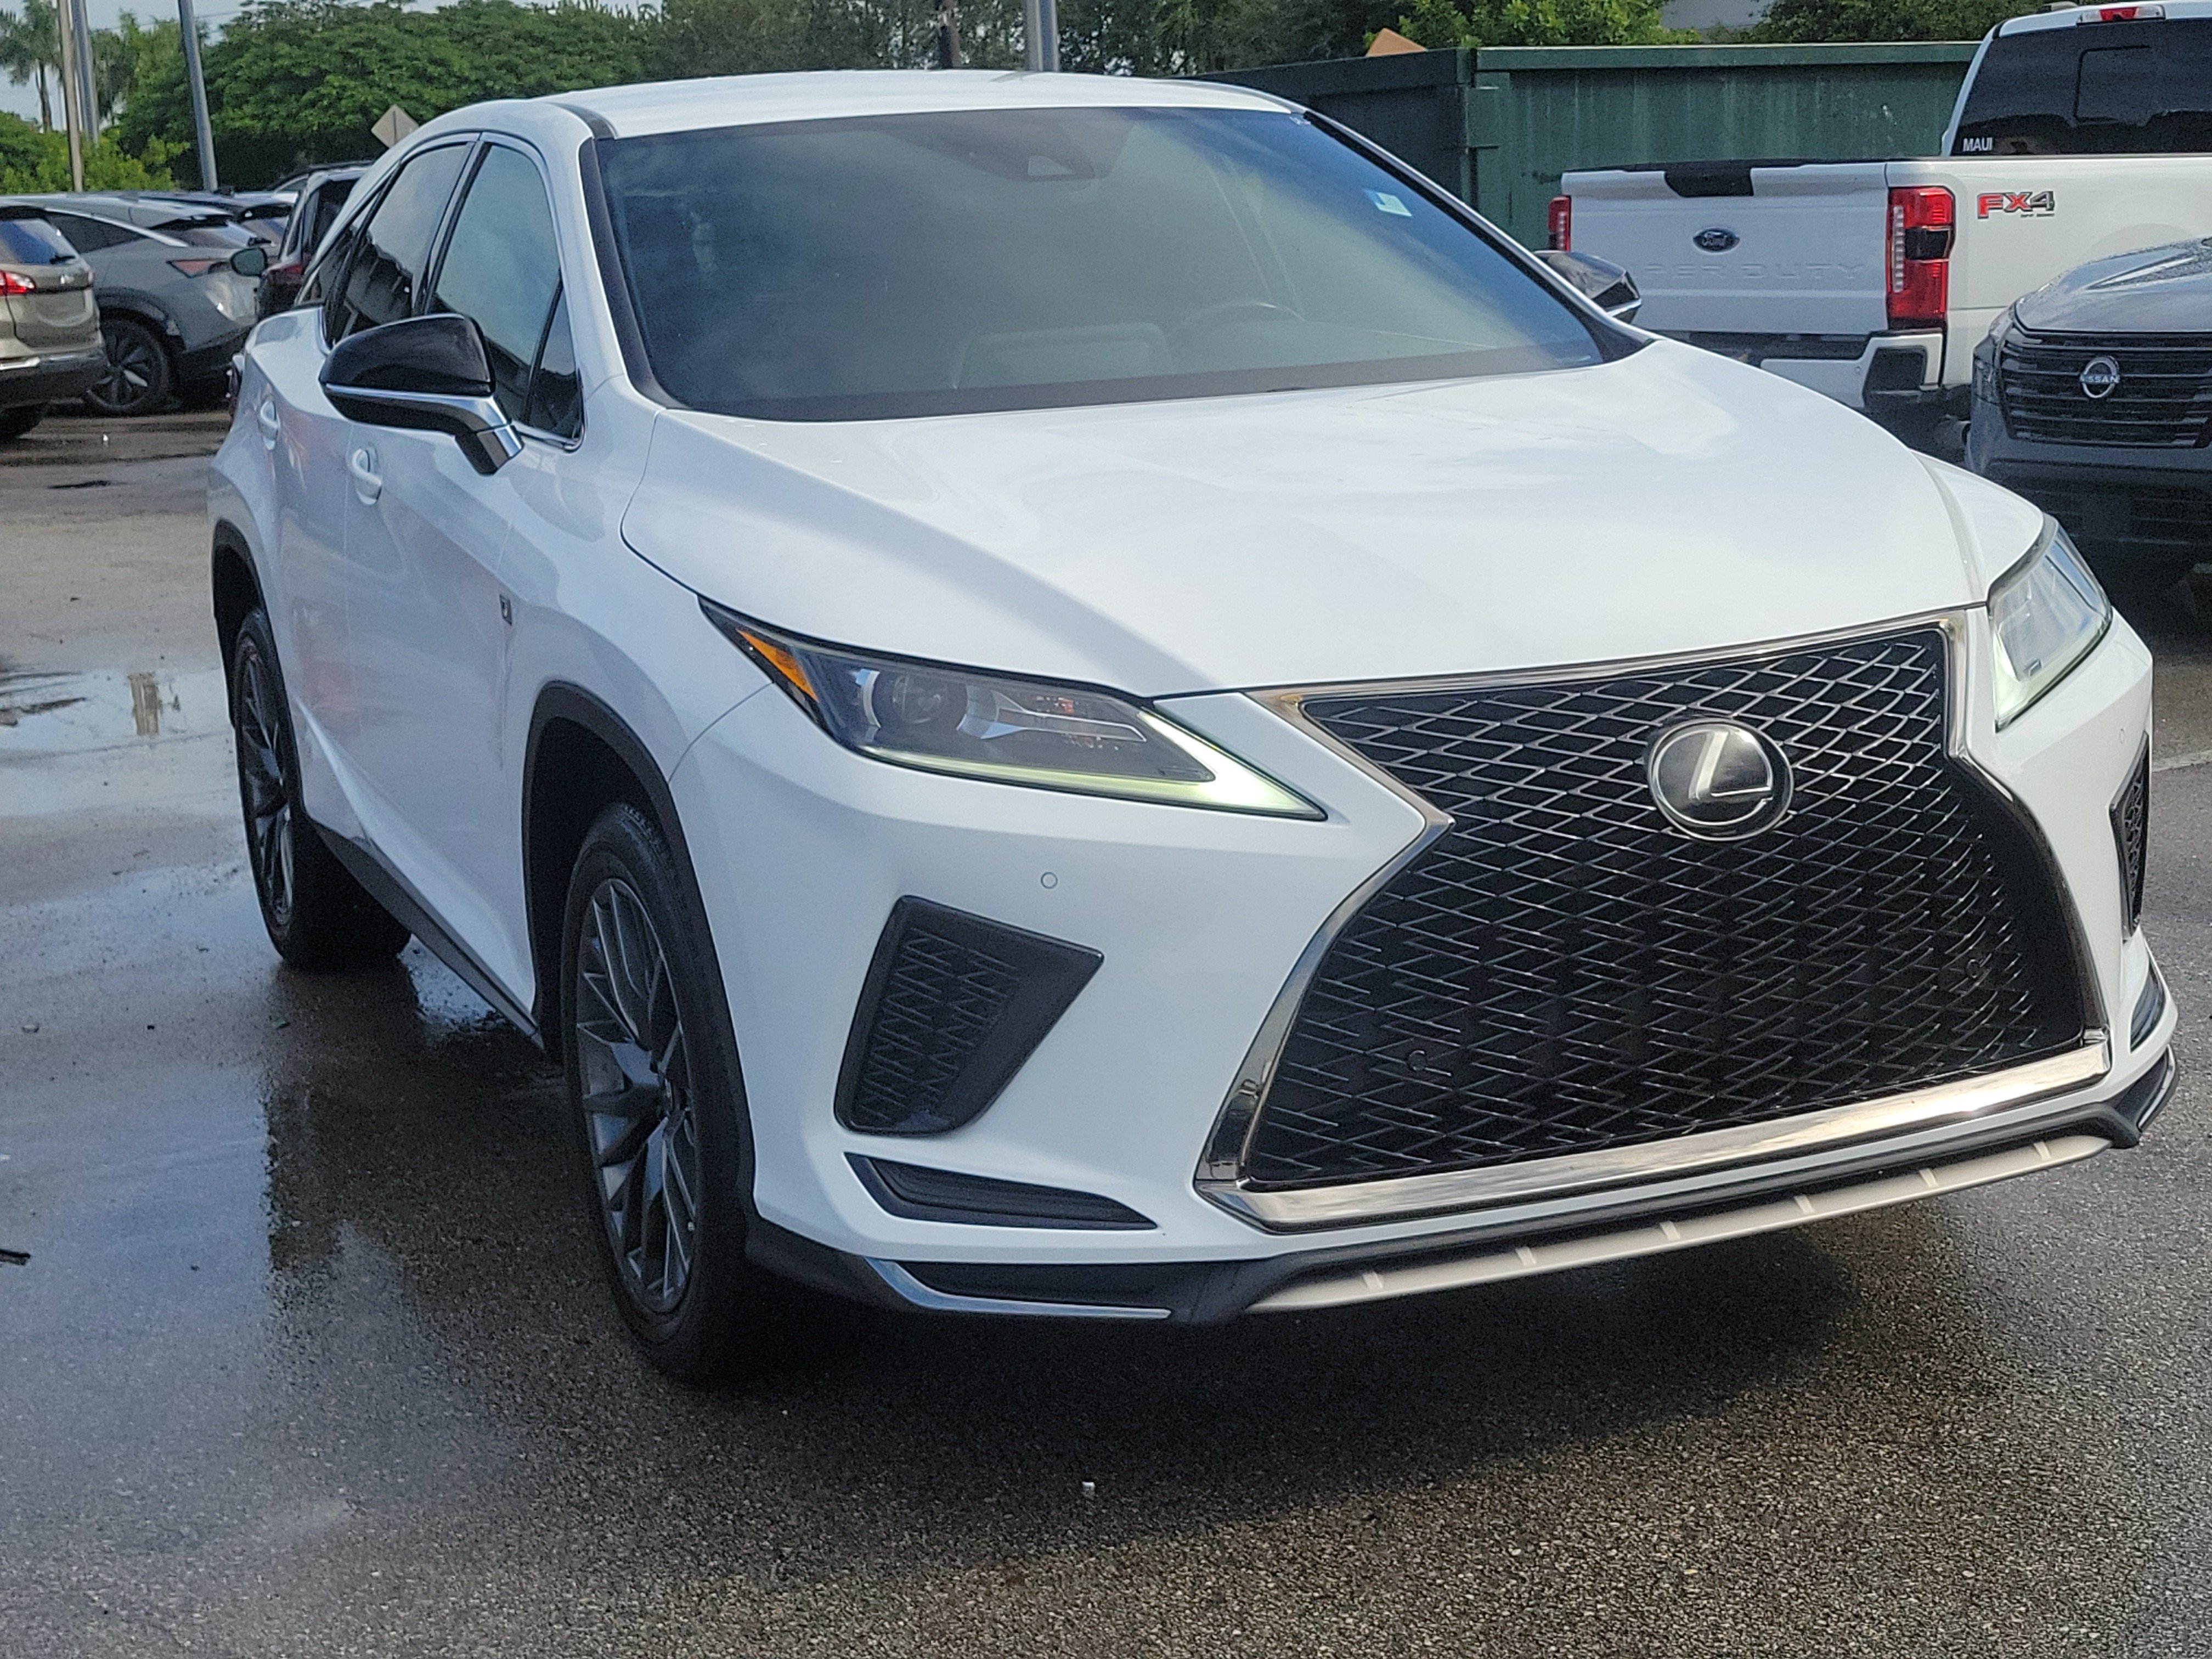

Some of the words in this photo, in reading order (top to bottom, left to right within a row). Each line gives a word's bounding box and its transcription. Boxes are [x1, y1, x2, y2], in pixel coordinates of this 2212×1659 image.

[1963, 137, 1993, 151] MAUI
[1977, 191, 2055, 219] FX4
[1740, 262, 1865, 278] DUTY
[2080, 375, 2120, 383] NISSAN
